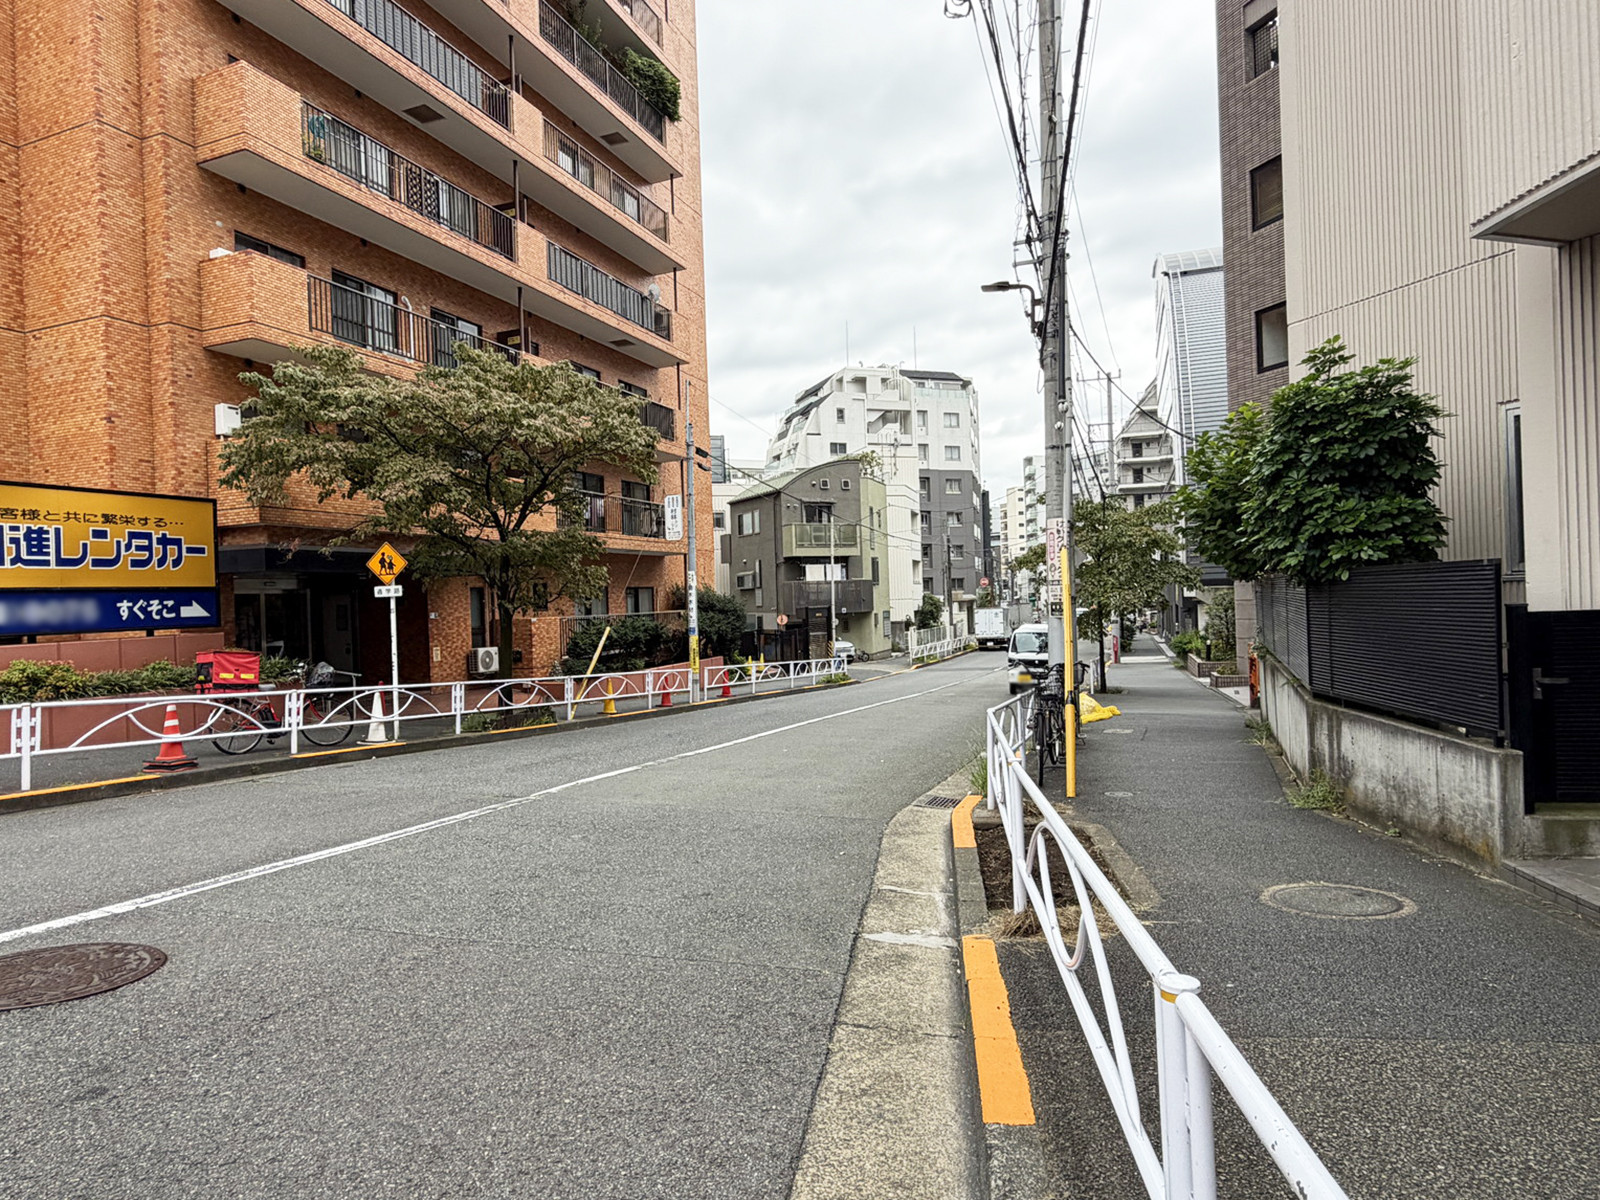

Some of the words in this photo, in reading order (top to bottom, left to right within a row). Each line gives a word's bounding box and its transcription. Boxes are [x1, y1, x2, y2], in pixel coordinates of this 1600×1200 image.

[0, 523, 207, 571] 進レンタカー
[116, 599, 176, 621] すぐそこ
